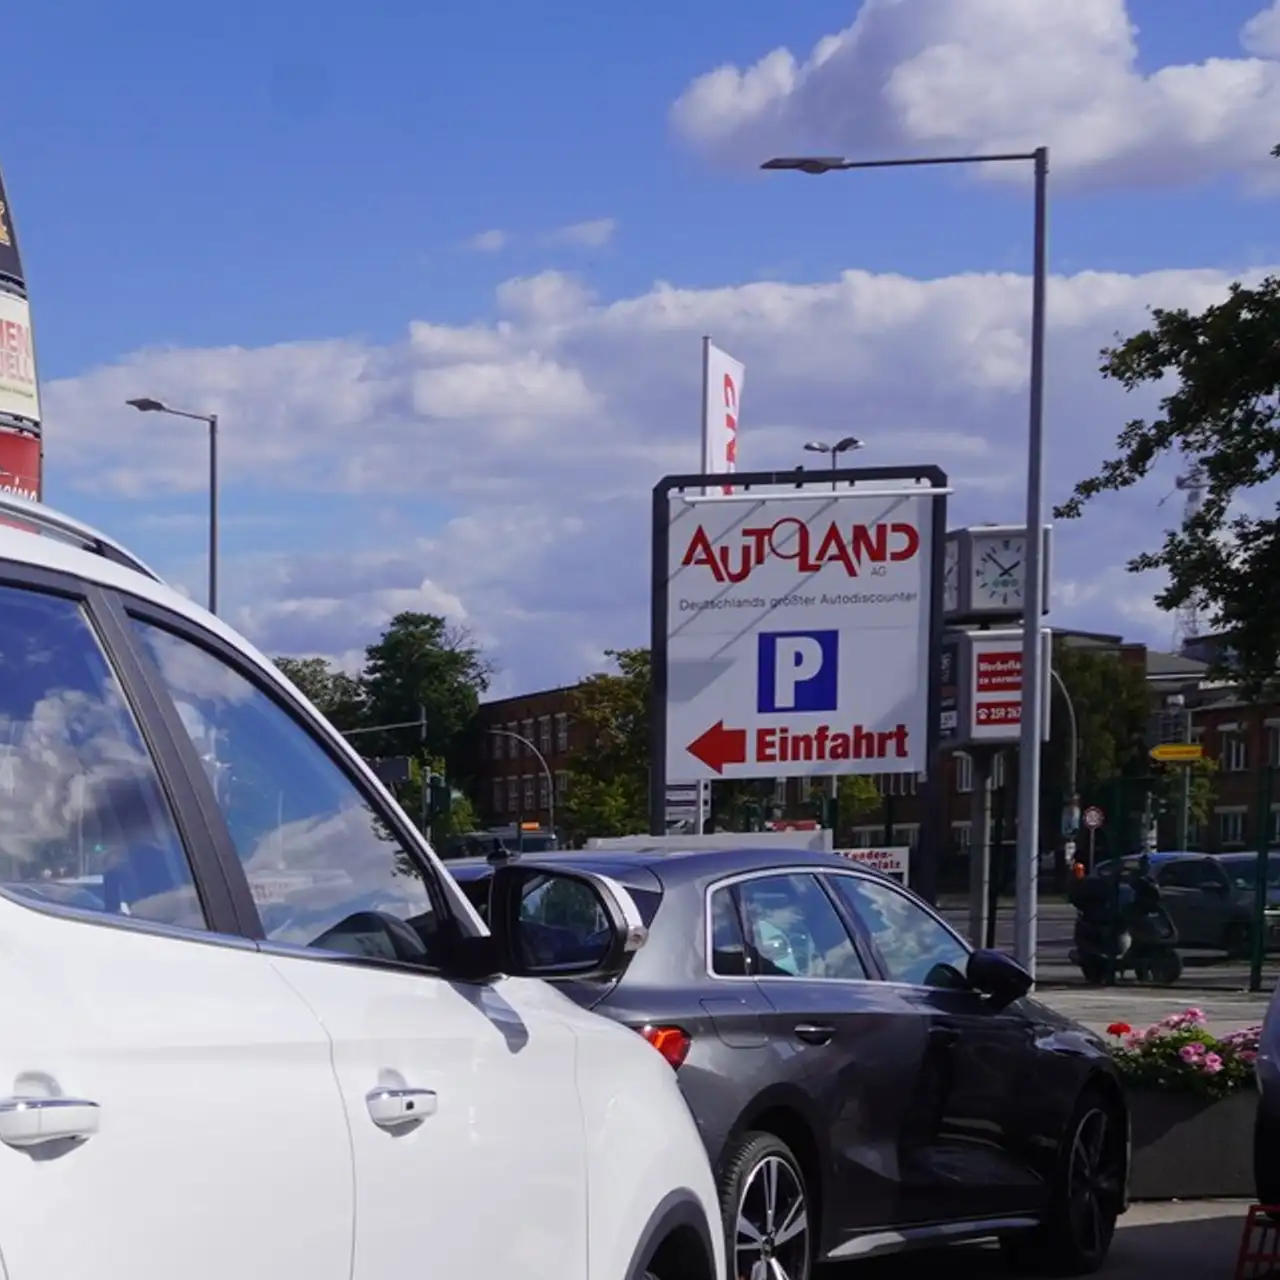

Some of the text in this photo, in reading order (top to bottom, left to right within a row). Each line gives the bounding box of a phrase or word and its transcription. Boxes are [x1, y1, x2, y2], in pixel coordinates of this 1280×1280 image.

[681, 517, 920, 584] AUTOLAND
[870, 566, 888, 578] AG
[678, 591, 918, 611] Deutschlands größter Autodiscounter
[774, 636, 824, 709] P
[756, 724, 909, 763] Einfahrt
